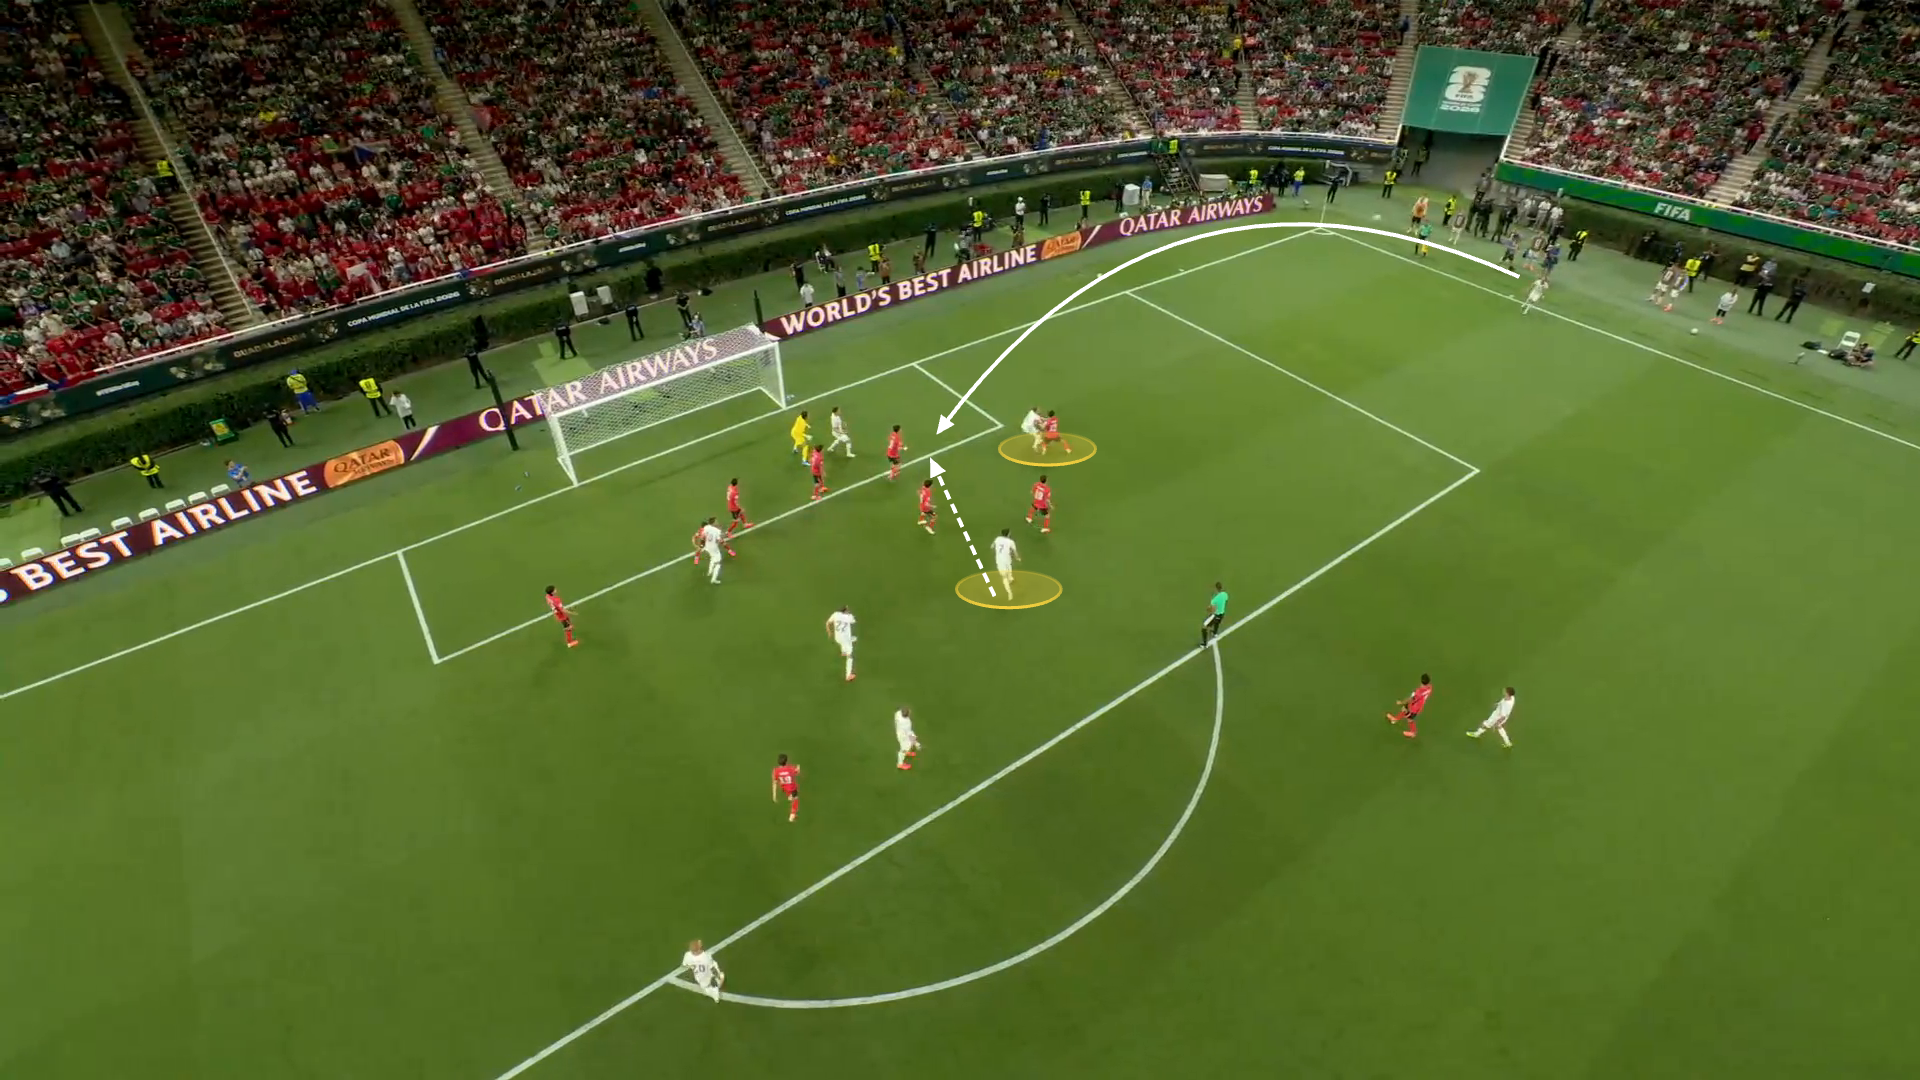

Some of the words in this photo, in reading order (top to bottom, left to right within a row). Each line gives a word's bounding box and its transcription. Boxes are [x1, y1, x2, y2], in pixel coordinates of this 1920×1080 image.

[1119, 209, 1182, 237] QATAR
[1187, 195, 1264, 224] AIRWAYS
[1653, 201, 1691, 222] FIFA
[896, 268, 952, 301] BEST
[957, 244, 1038, 284] AIRLINE
[347, 316, 368, 327] COPA
[368, 308, 400, 320] MUNDIAL
[400, 303, 411, 312] DE
[410, 302, 420, 310] LA
[419, 297, 436, 307] FIFA
[435, 291, 460, 302] 2026
[478, 380, 588, 432] QATAR
[600, 337, 718, 394] AIRWAYS
[333, 448, 390, 473] QATAR
[9, 530, 133, 591] BEST
[150, 469, 318, 546] AIRLINE
